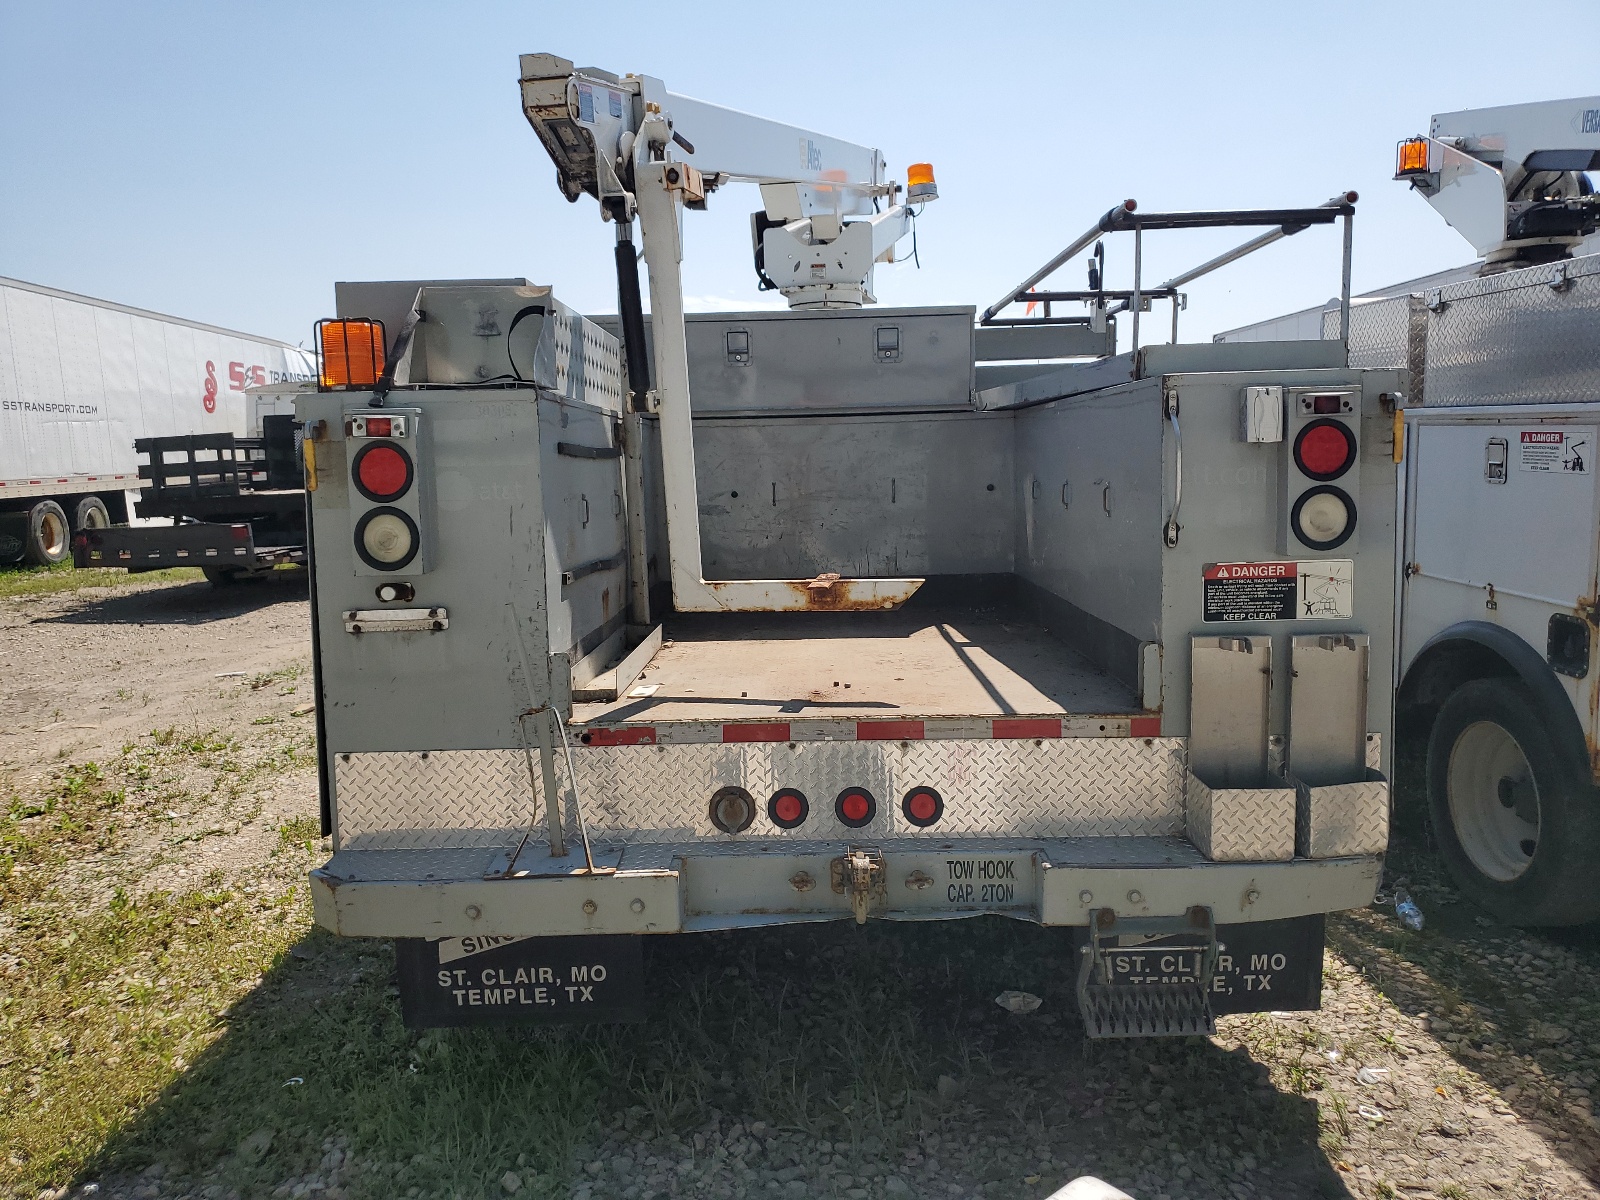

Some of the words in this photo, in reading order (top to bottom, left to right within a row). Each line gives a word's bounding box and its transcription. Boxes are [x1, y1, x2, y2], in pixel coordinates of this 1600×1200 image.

[229, 361, 266, 391] S&S
[2, 400, 98, 415] SSTRANSPORT.COM
[1532, 433, 1560, 442] DANGER
[1232, 566, 1285, 577] DANGER
[1247, 612, 1277, 620] CLEAR
[946, 860, 974, 879] TOW
[978, 860, 1014, 879] HOOK
[947, 883, 975, 902] CAP.
[981, 884, 1014, 902] 2TON
[1116, 955, 1150, 973] ST.
[1160, 955, 1240, 975] CLR,
[1250, 953, 1286, 971] MO
[437, 969, 472, 987] ST.
[481, 967, 560, 986] CLAIR,
[571, 965, 607, 982] MO
[1243, 974, 1272, 991] TX
[452, 987, 556, 1006] TEMPLE,
[564, 986, 594, 1003] TX
